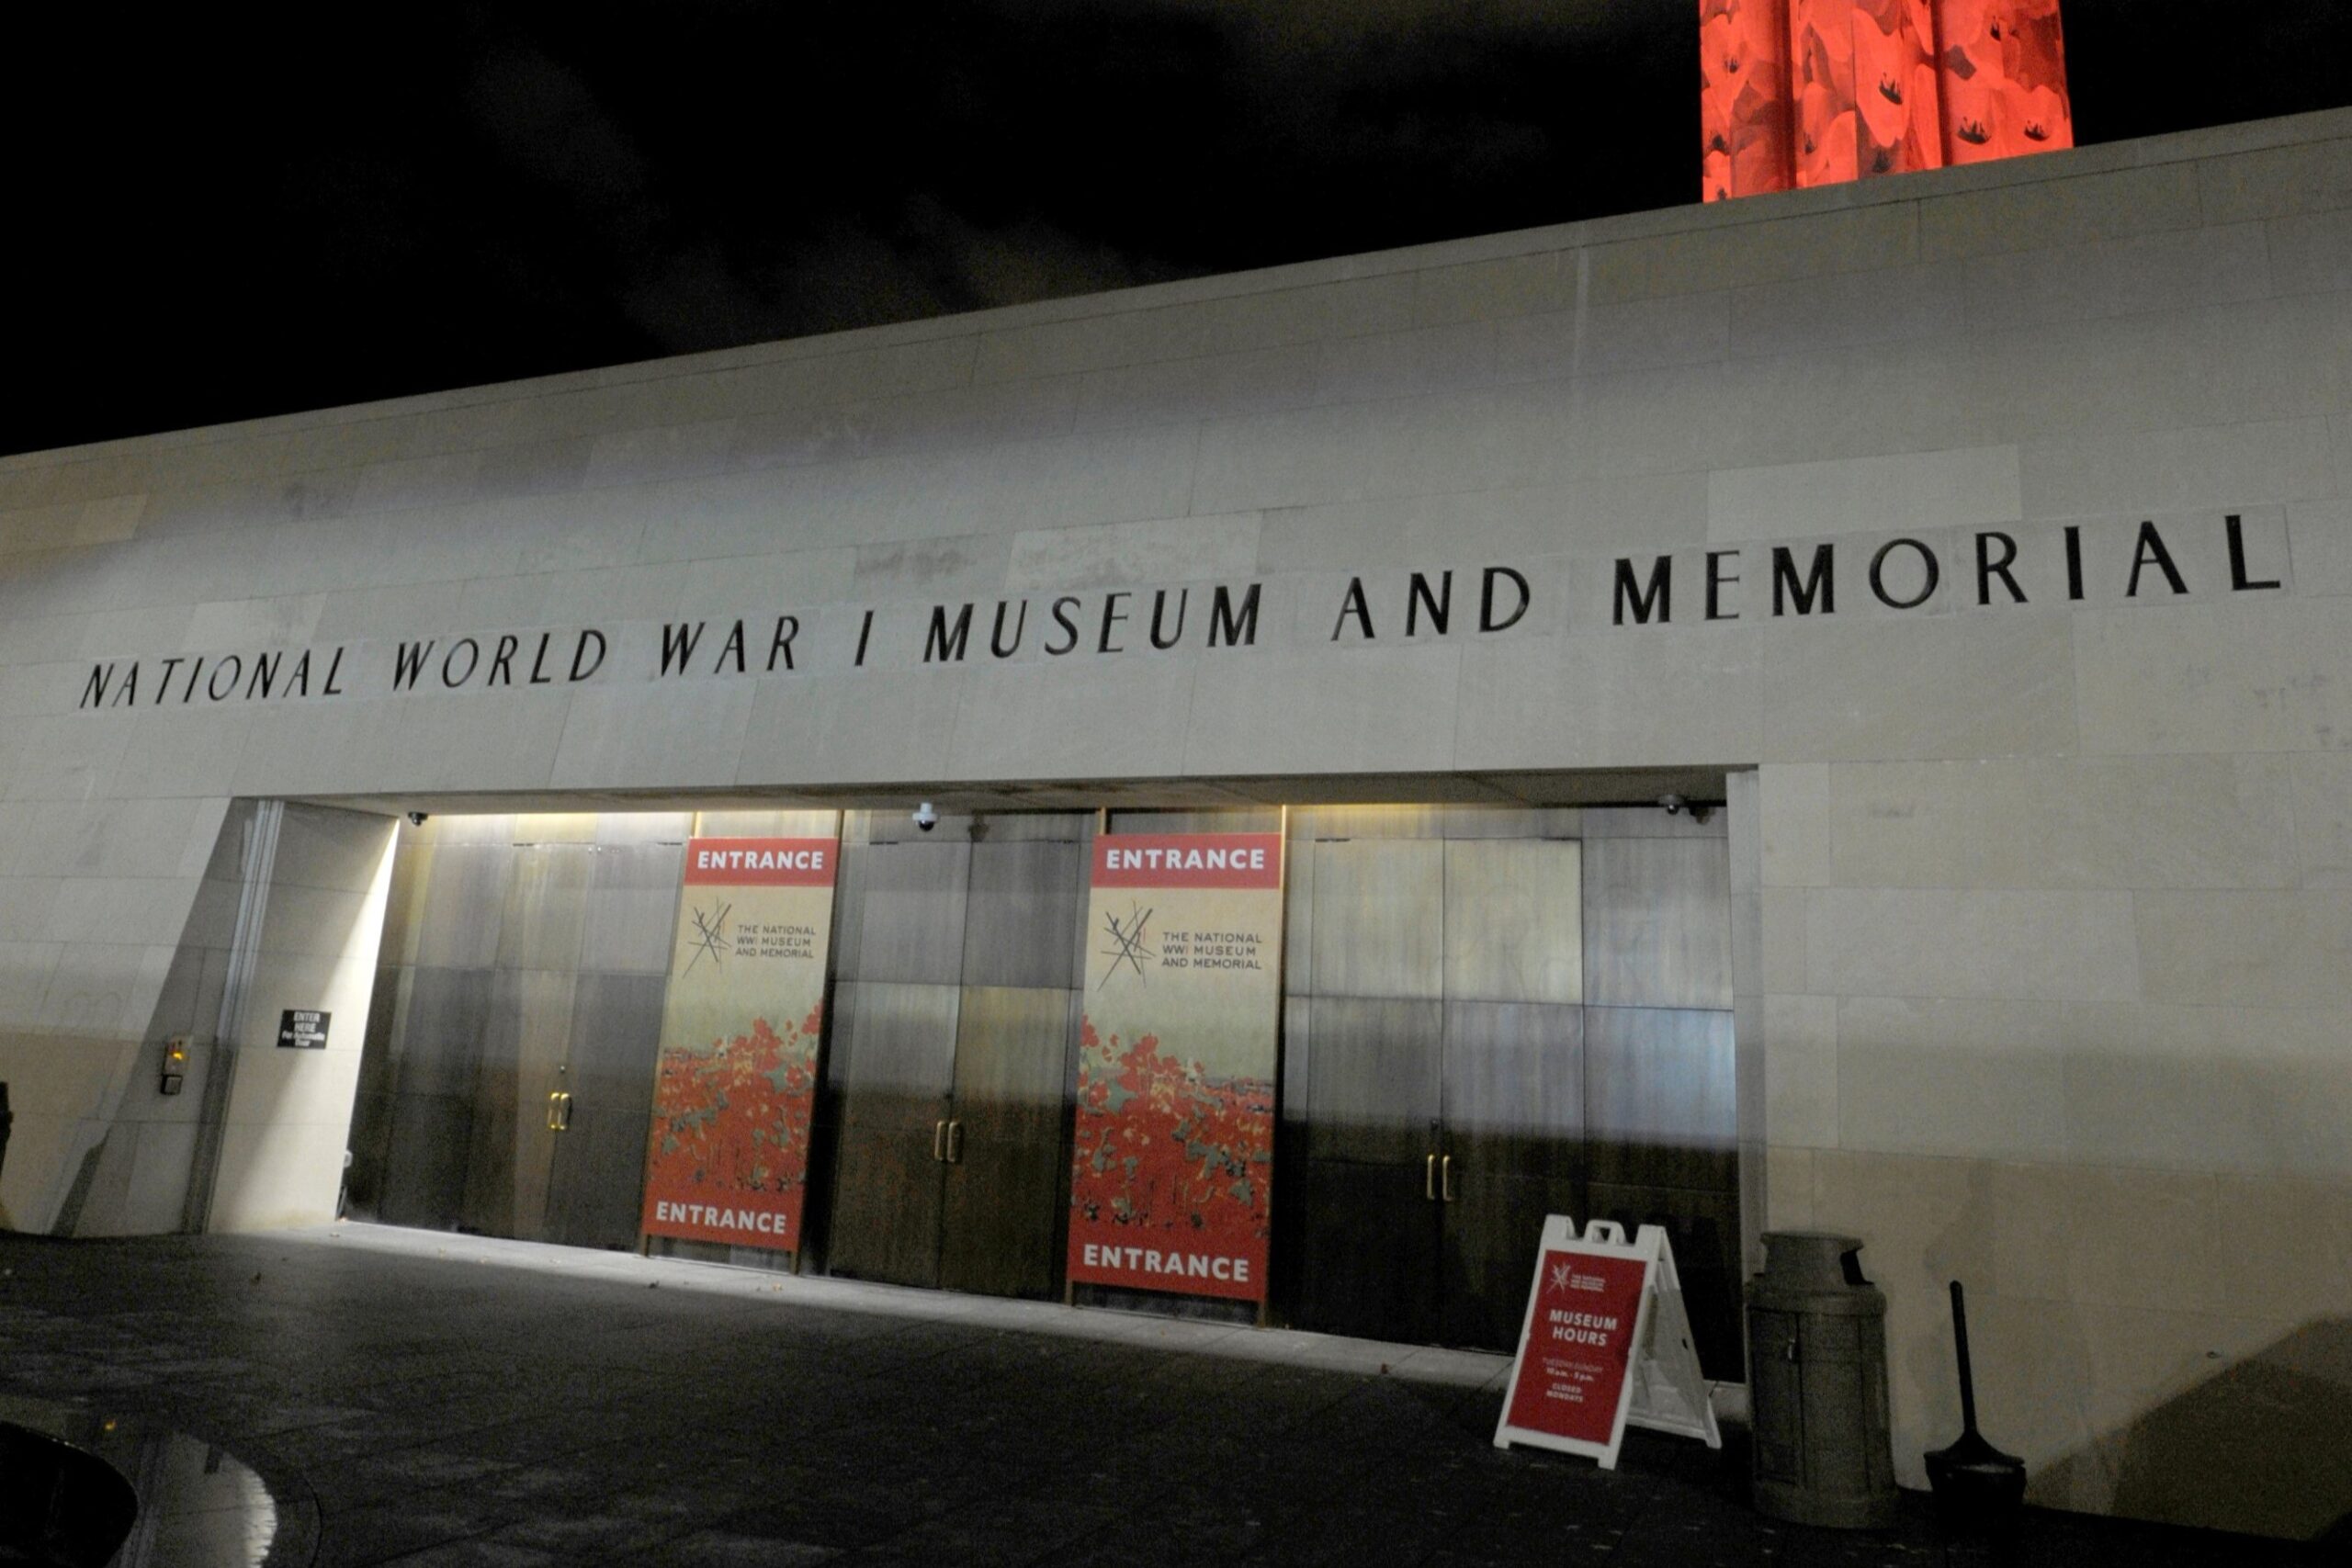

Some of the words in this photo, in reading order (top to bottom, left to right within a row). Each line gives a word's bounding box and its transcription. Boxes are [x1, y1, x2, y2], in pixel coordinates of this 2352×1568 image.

[79, 646, 344, 710] NATIONAL
[390, 628, 607, 692] WORLD
[660, 615, 800, 677] WAR
[854, 610, 875, 667] I
[922, 582, 1262, 663] MUSEUM
[1330, 567, 1531, 641] AND
[1611, 514, 2281, 626] MEMORIAL
[697, 851, 824, 870] ENTRANCE
[1106, 849, 1265, 869] ENTRANCE
[738, 925, 759, 934] THE
[763, 925, 816, 935] NATIONAL
[737, 936, 758, 945] WWI
[762, 937, 811, 947] MUSEUM
[1163, 931, 1189, 942] THE
[1194, 932, 1262, 943] NATIONAL
[736, 948, 757, 957] AND
[760, 948, 815, 959] MEMORIAL
[1162, 945, 1189, 955] WWI
[1194, 945, 1256, 956] MUSEUM
[1161, 958, 1188, 967] AND
[1193, 959, 1262, 969] MEMORIAL
[294, 1011, 321, 1022] ENTER
[294, 1022, 316, 1032] HERE
[656, 1201, 787, 1234] ENTRANCE
[1083, 1244, 1250, 1281] ENTRANCE
[1549, 1309, 1618, 1331] MUSEUM
[1552, 1325, 1608, 1347] HOURS
[1552, 1382, 1582, 1393] CLOSED
[1546, 1390, 1584, 1403] MONDAYS
